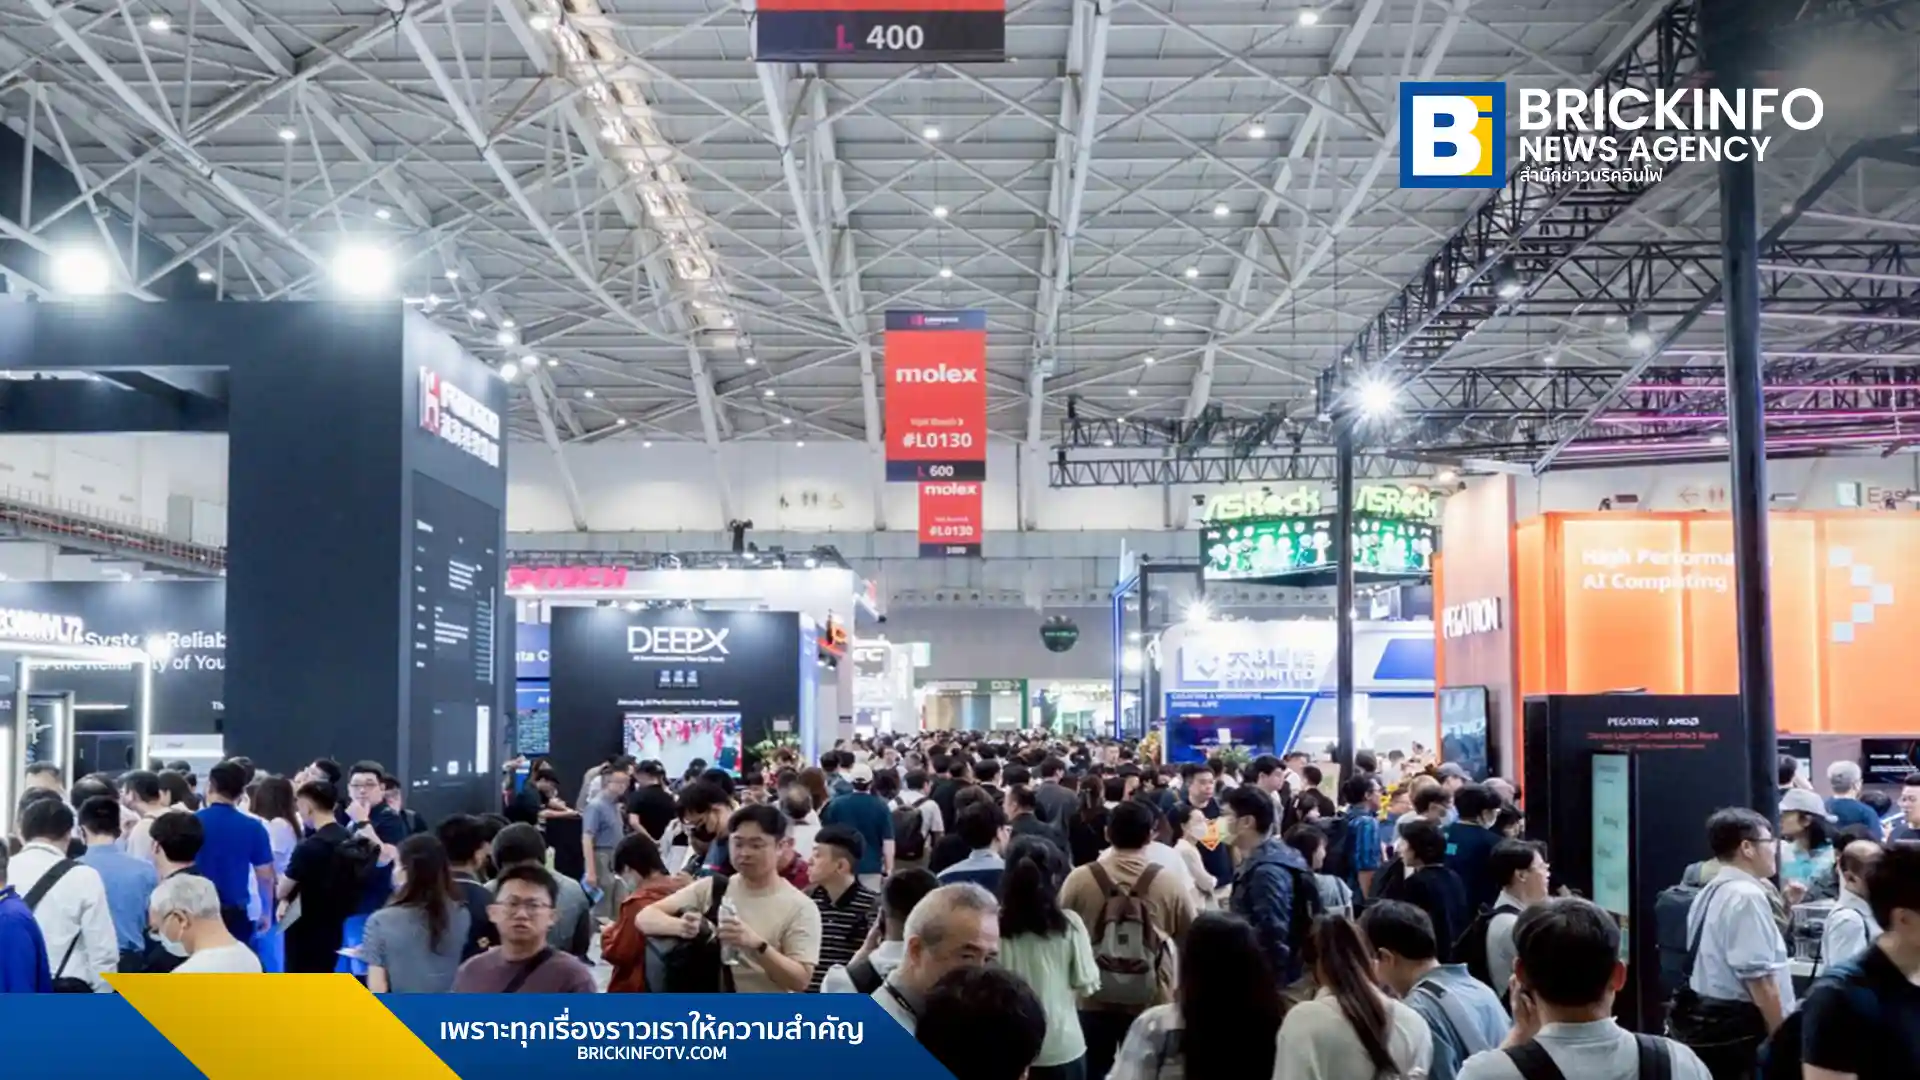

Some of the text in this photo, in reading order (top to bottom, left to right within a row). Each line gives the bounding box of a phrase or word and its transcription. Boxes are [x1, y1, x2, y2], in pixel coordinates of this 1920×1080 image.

[836, 24, 924, 49] L 400
[896, 363, 977, 383] molex
[903, 432, 972, 448] #L0130
[929, 465, 954, 477] 600
[925, 483, 978, 495] molex
[627, 626, 730, 654] DEEPX
[173, 655, 192, 670] of
